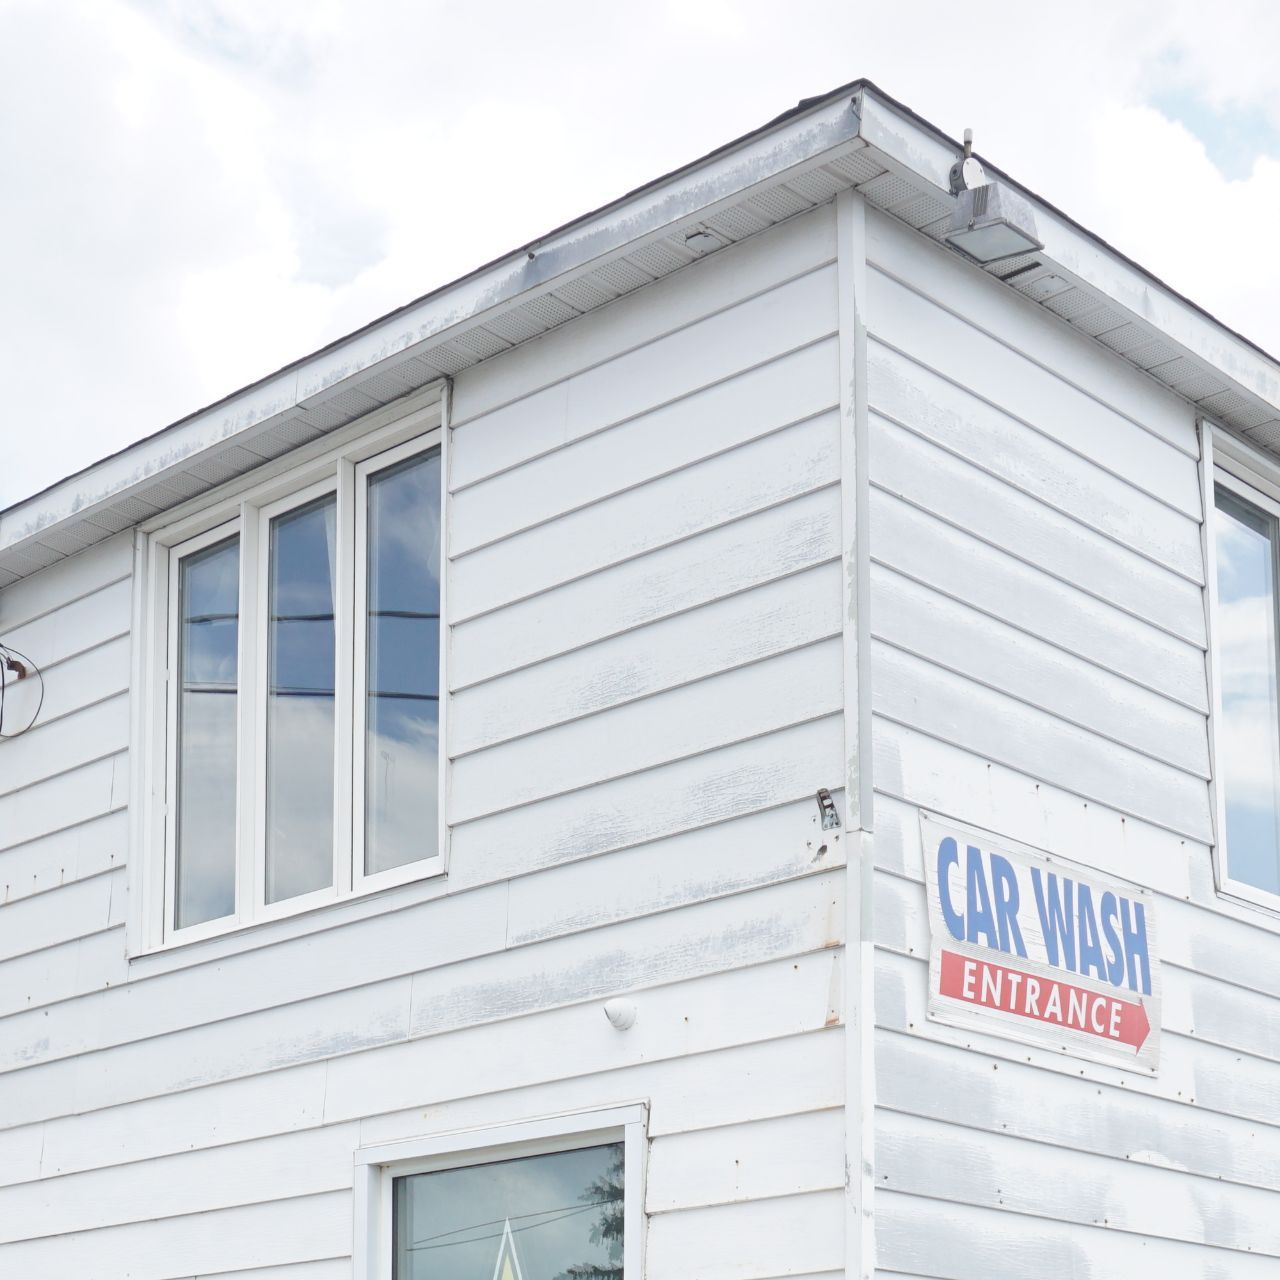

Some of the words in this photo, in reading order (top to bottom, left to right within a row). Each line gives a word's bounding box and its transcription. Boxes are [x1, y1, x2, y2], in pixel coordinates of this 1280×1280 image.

[937, 836, 1028, 959] CAR
[1030, 866, 1152, 996] WASH
[962, 960, 1121, 1038] ENTRANCE
